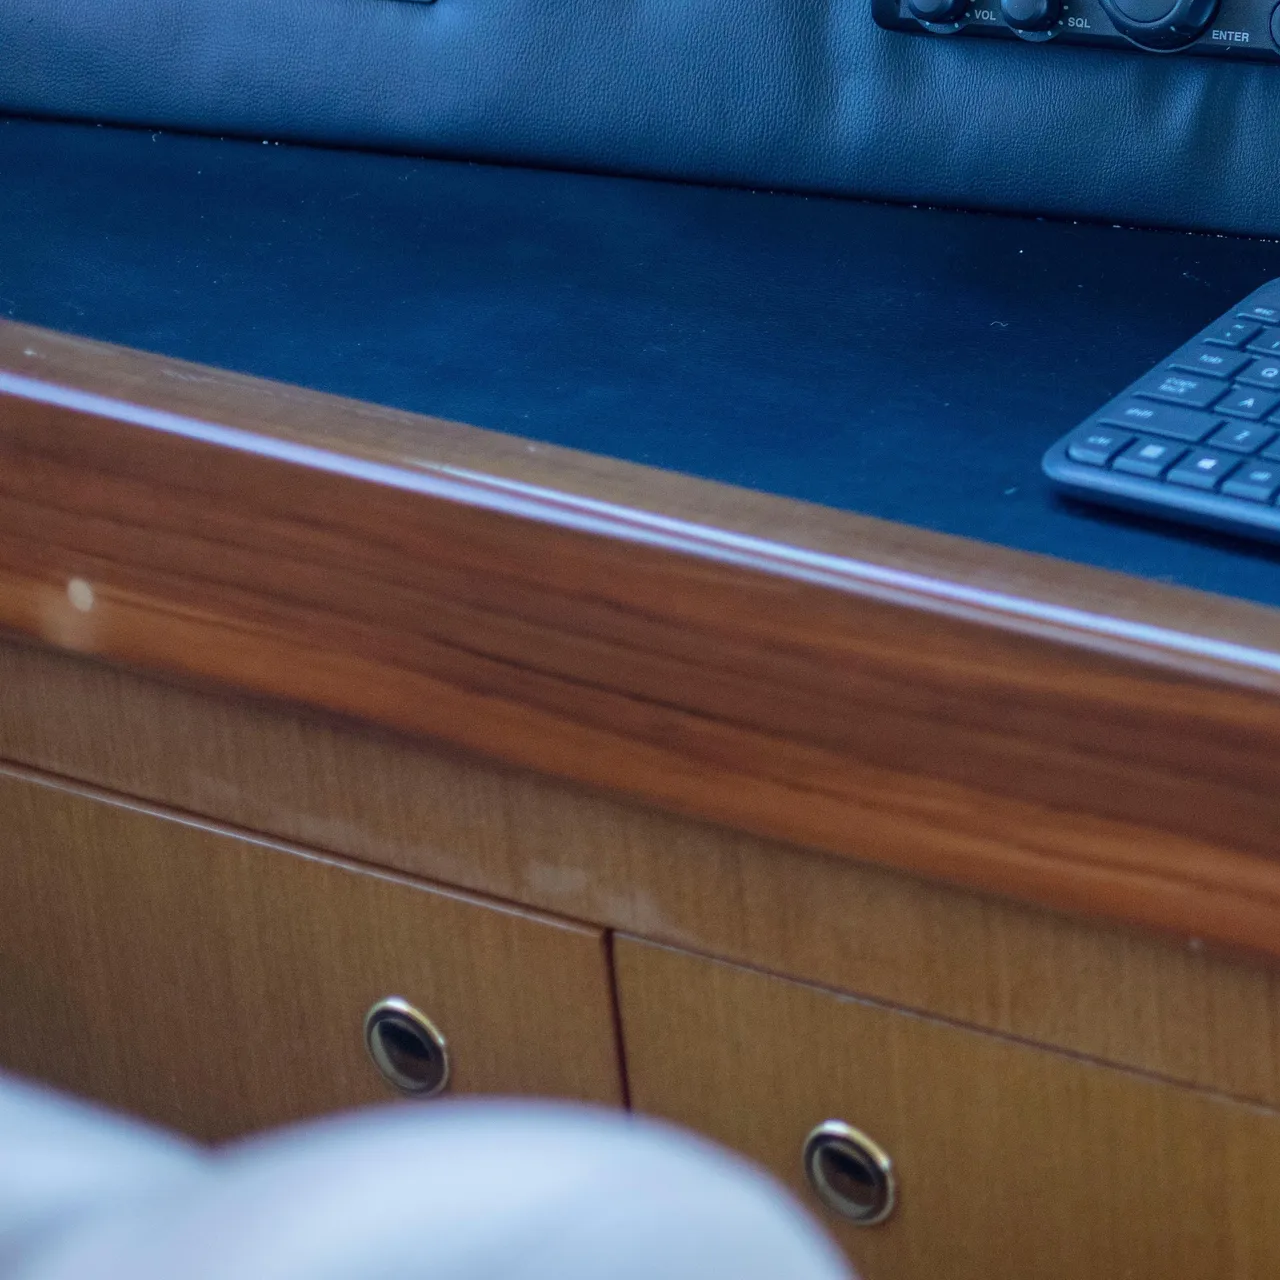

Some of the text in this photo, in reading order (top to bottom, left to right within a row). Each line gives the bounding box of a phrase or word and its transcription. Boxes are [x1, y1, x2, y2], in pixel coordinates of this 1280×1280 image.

[974, 9, 997, 21] VOL
[1067, 17, 1092, 29] SQL
[1211, 29, 1250, 43] ENTER
